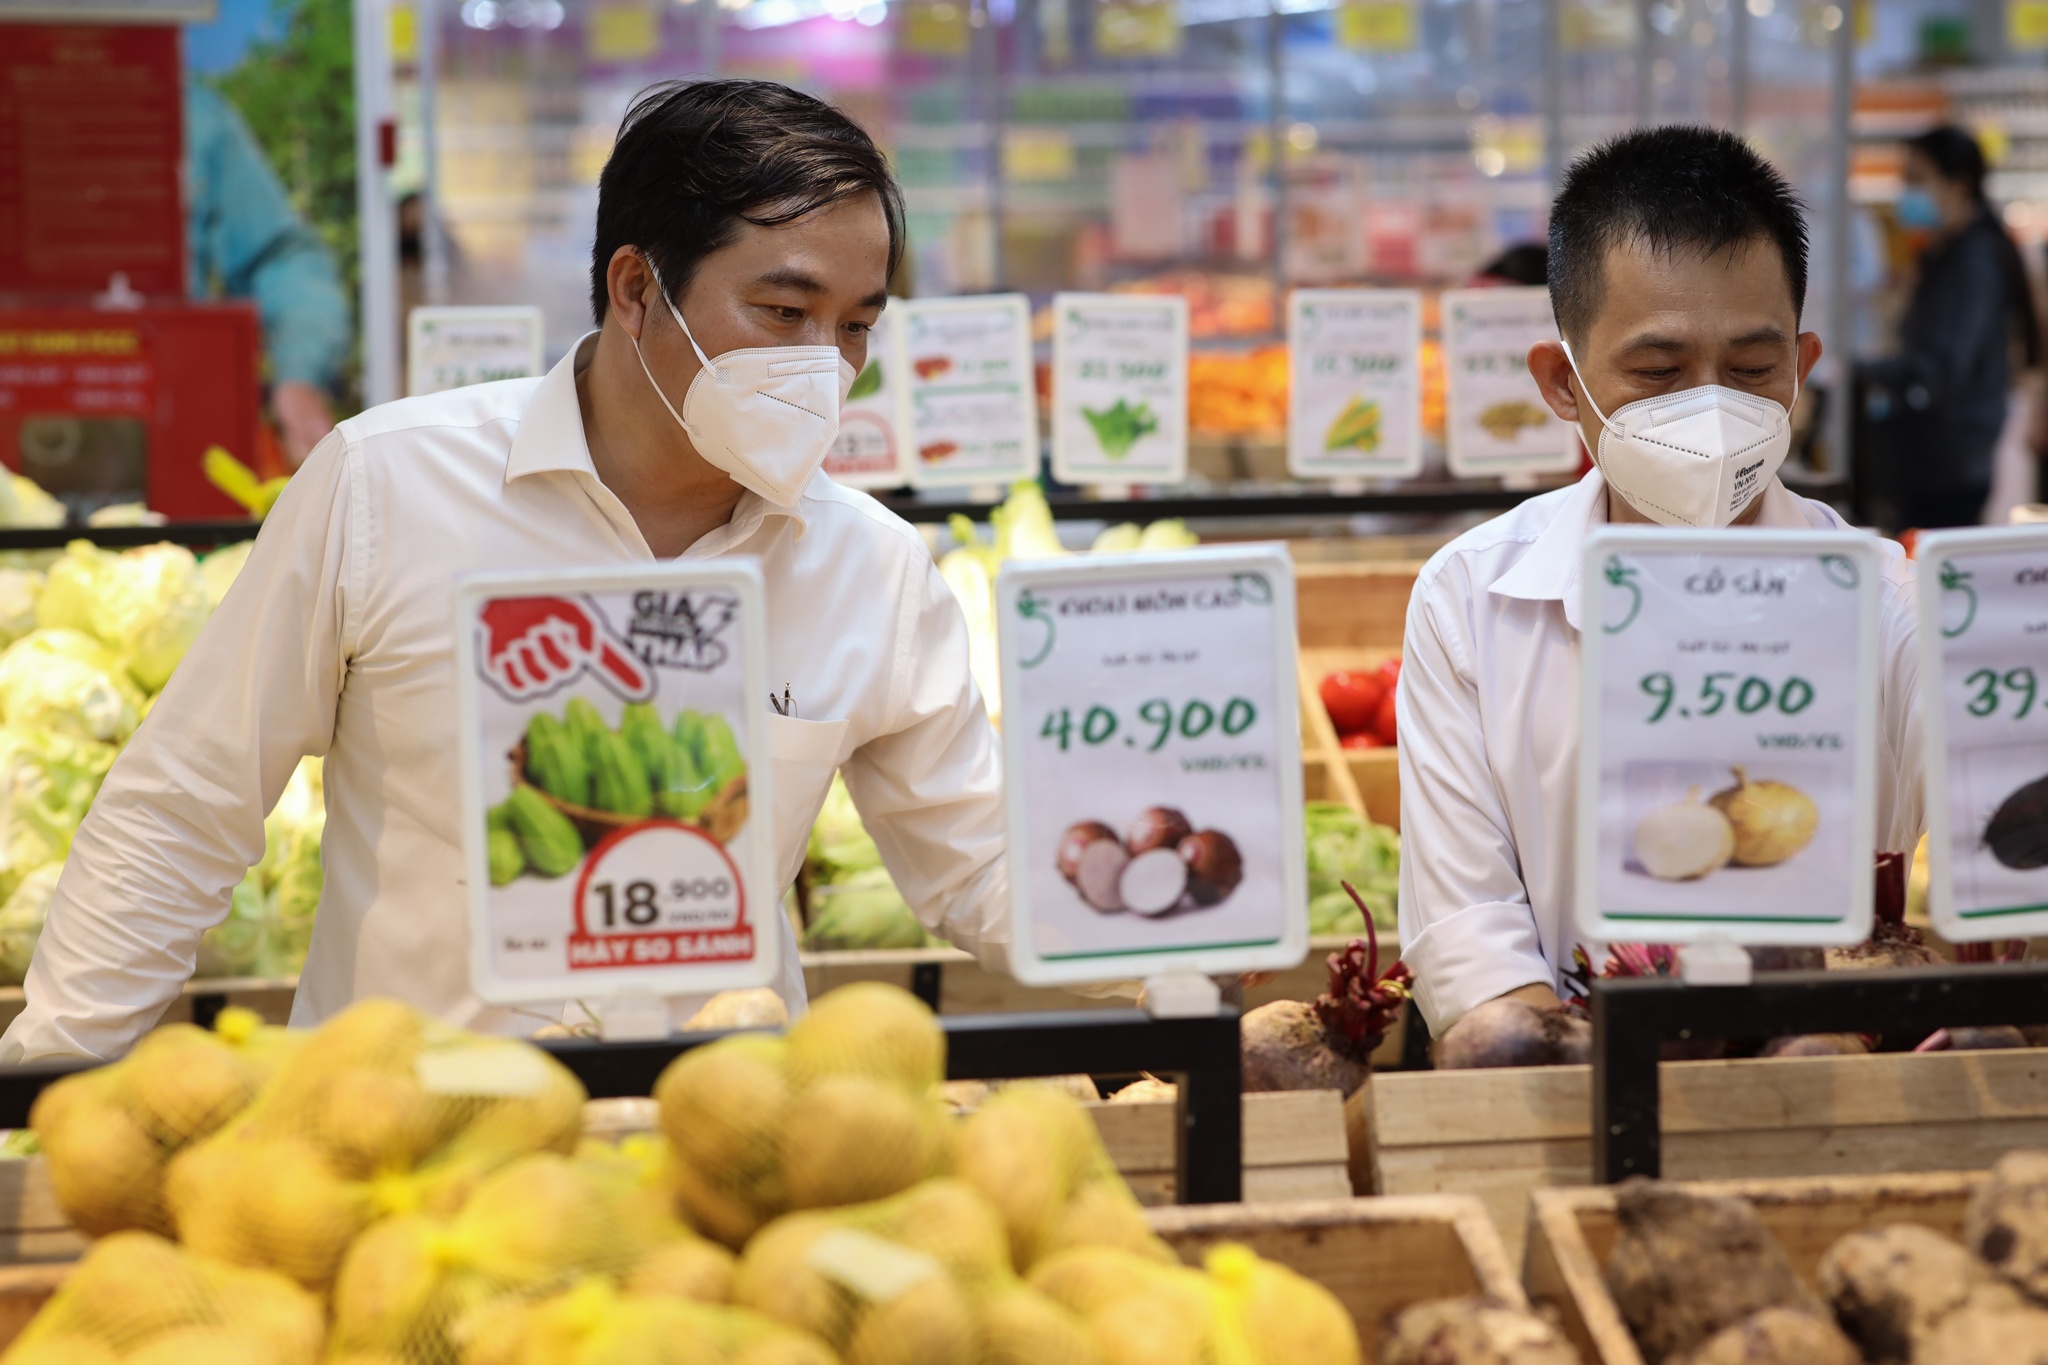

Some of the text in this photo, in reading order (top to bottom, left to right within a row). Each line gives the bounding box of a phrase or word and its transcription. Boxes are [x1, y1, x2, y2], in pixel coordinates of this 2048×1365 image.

[1638, 672, 1816, 724] 9.500
[1040, 696, 1257, 753] 40.900
[631, 935, 672, 961] SO
